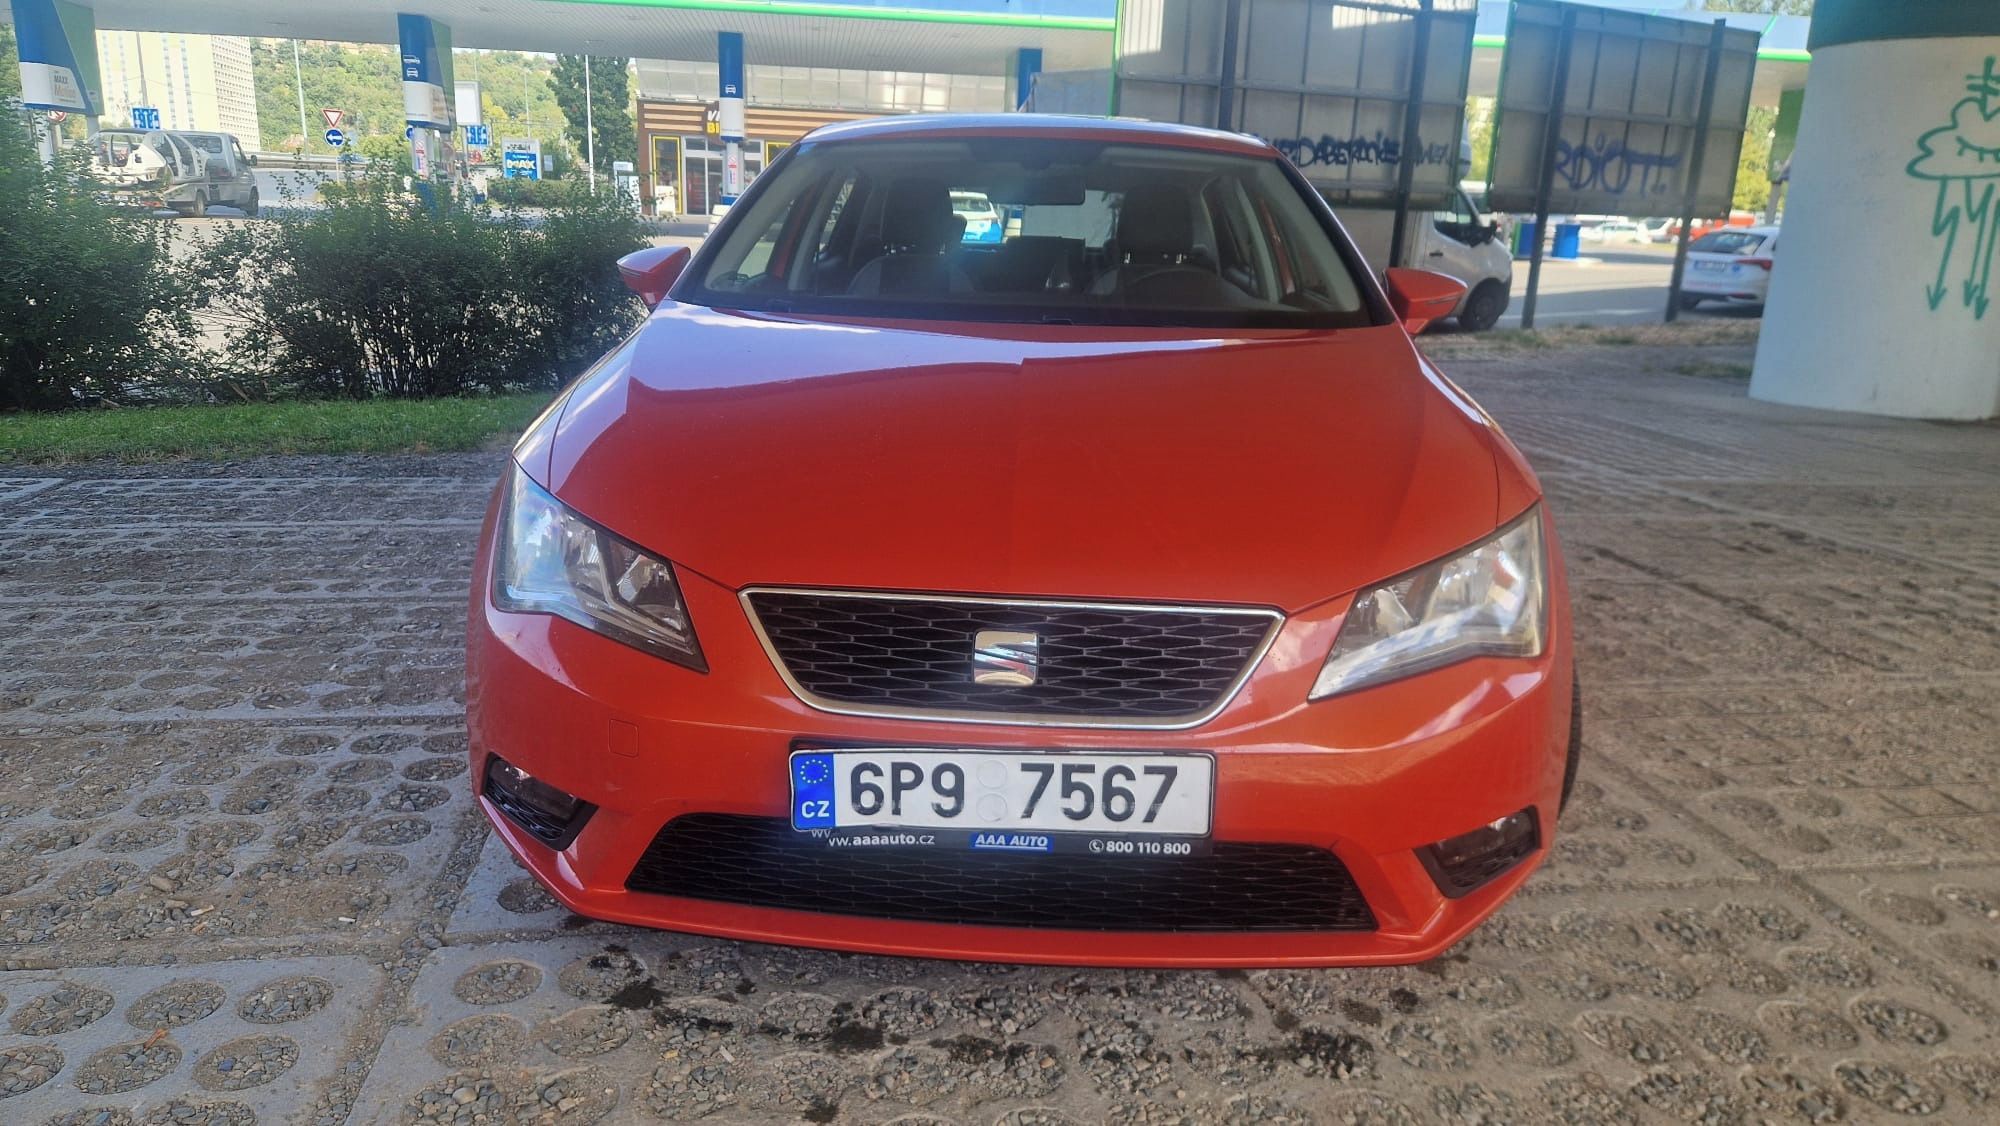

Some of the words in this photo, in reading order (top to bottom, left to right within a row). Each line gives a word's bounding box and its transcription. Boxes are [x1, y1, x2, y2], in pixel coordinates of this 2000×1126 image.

[849, 761, 966, 819] 6P9
[1020, 762, 1179, 824] 7567
[801, 801, 830, 818] CZ
[975, 834, 1006, 846] AAA
[1010, 836, 1048, 847] AUTO
[1106, 841, 1134, 853] 800
[1138, 842, 1161, 853] 110
[1163, 842, 1191, 855] 800
